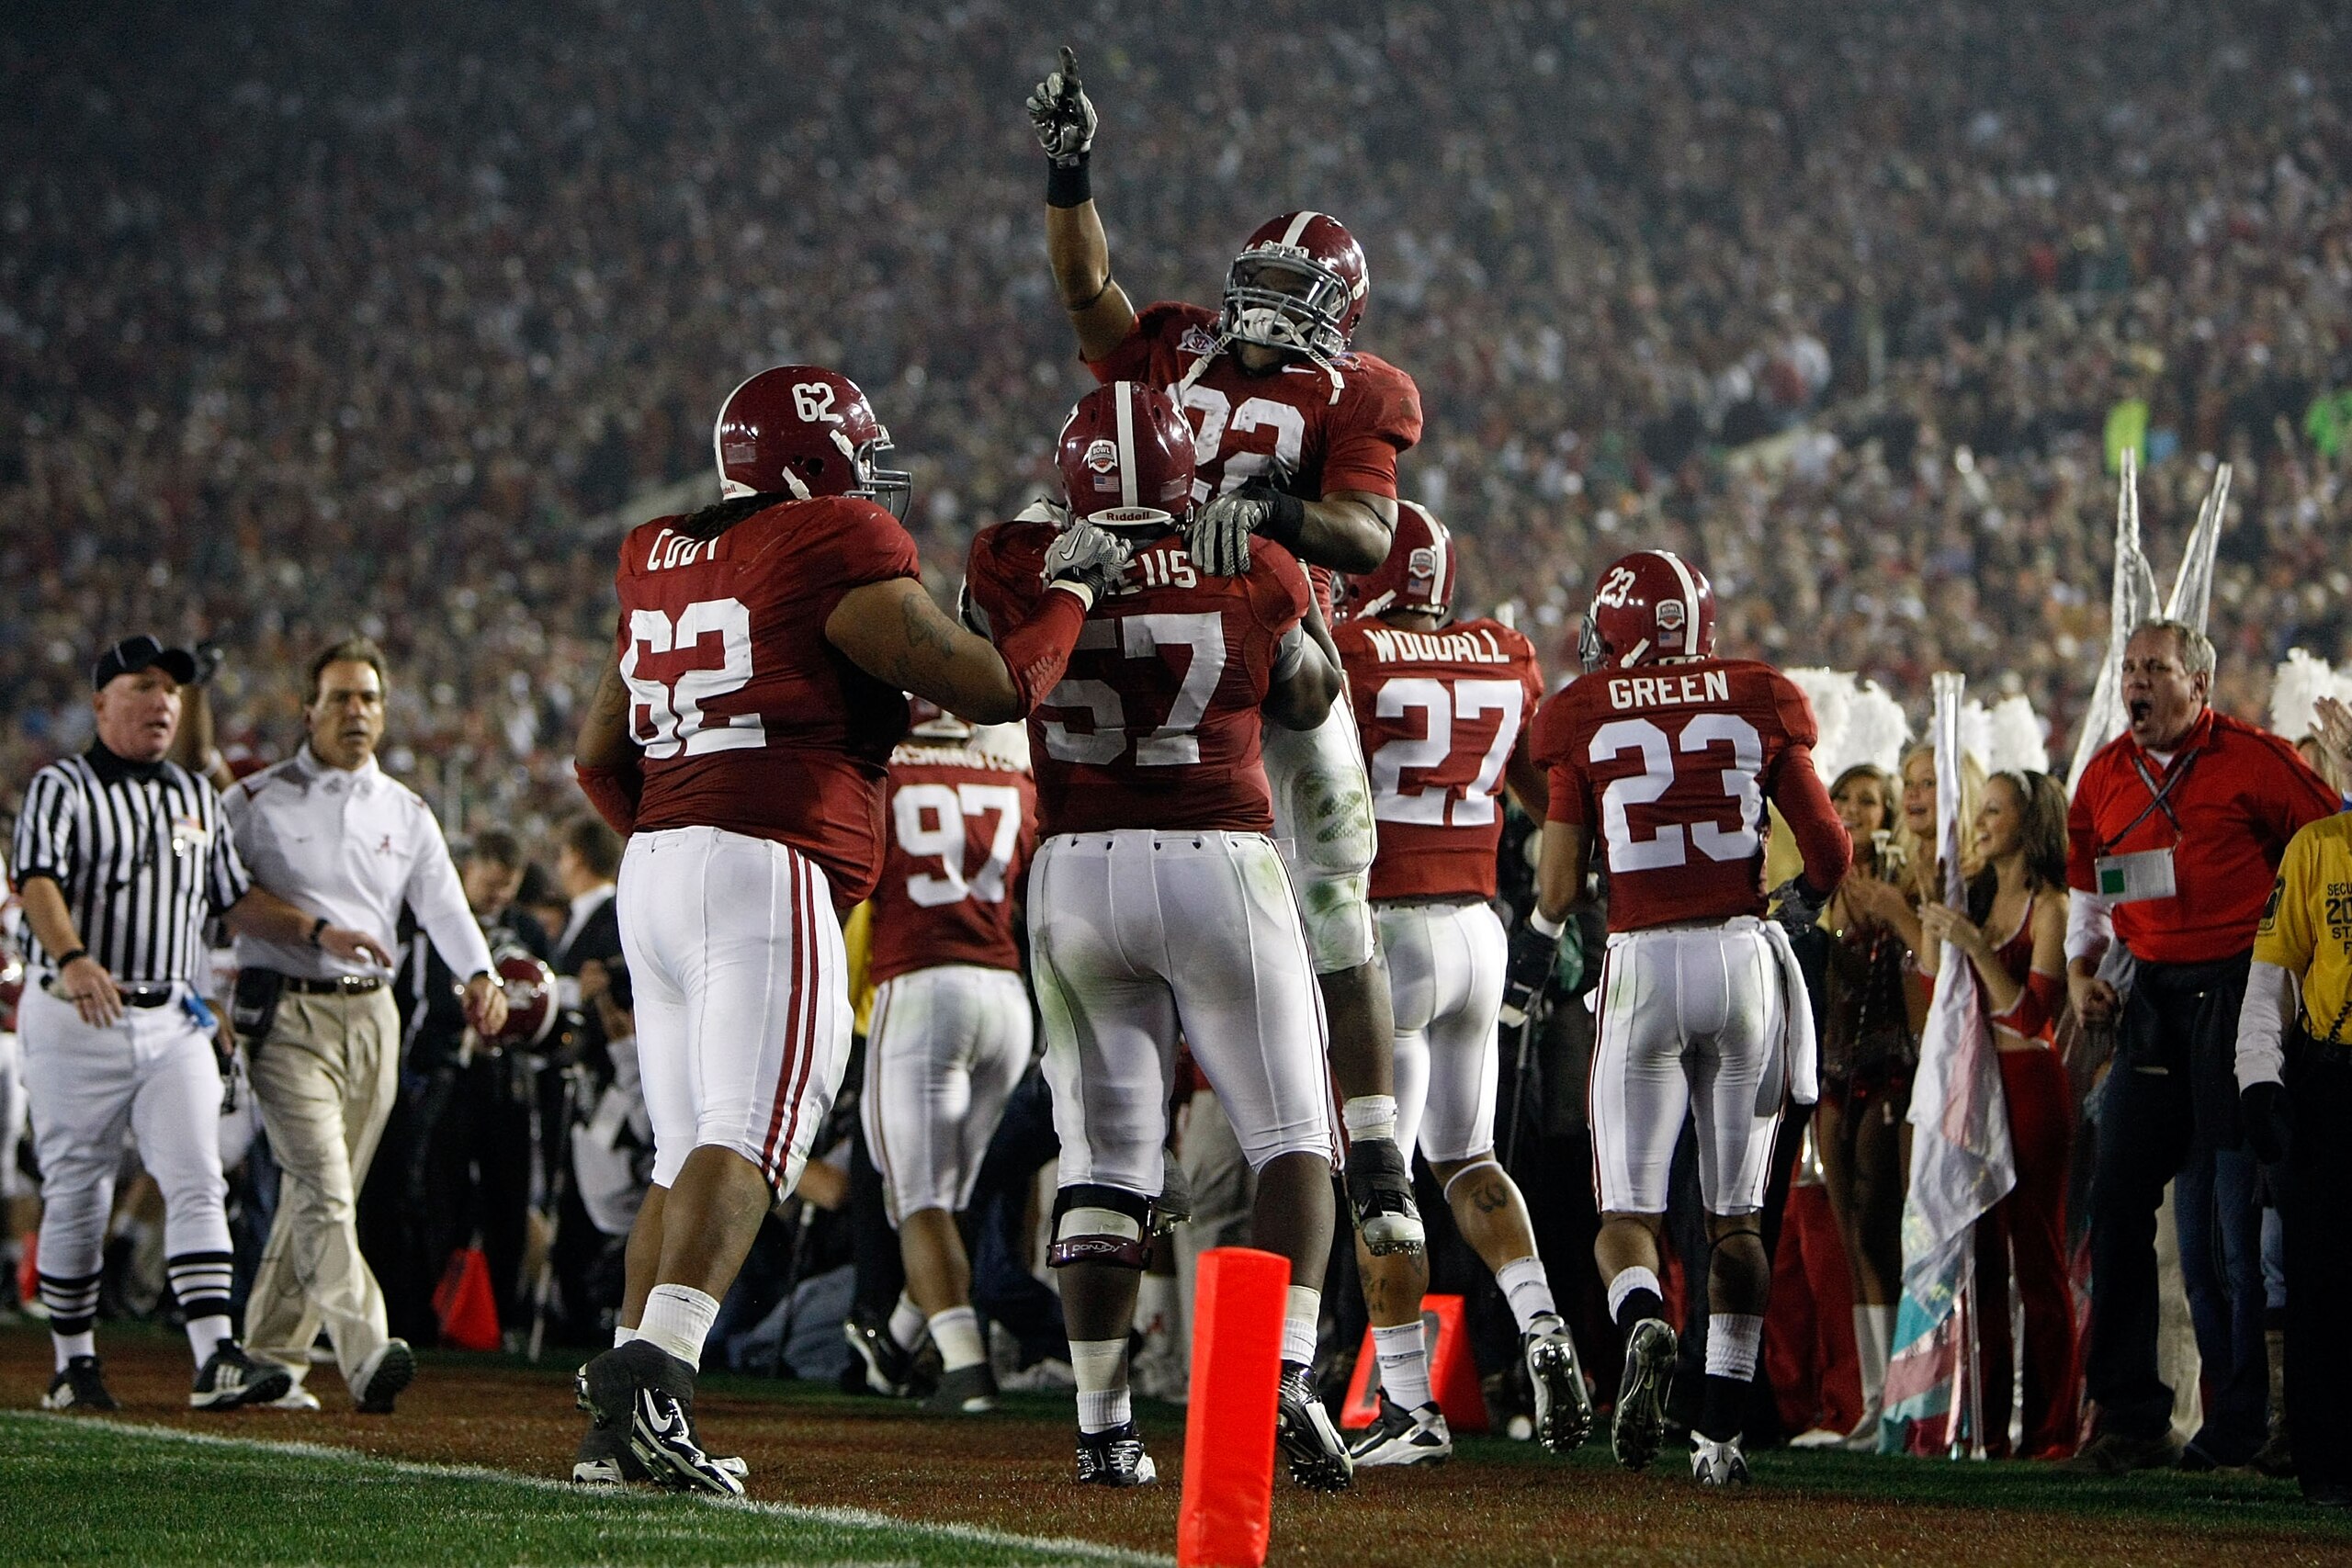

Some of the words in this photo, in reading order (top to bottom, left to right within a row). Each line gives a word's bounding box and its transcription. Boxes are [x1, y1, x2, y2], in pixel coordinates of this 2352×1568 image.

[791, 382, 840, 423] 62
[1092, 446, 1111, 455] BOWL
[1106, 512, 1149, 522] Riddell
[1600, 567, 1635, 608] 23
[618, 597, 766, 760] 62
[1040, 611, 1227, 766] 57
[1608, 670, 1729, 709] GREEN
[1372, 677, 1523, 826] 27
[1589, 713, 1762, 874] 23
[892, 783, 1022, 908] 97
[2332, 926, 2352, 940] ST
